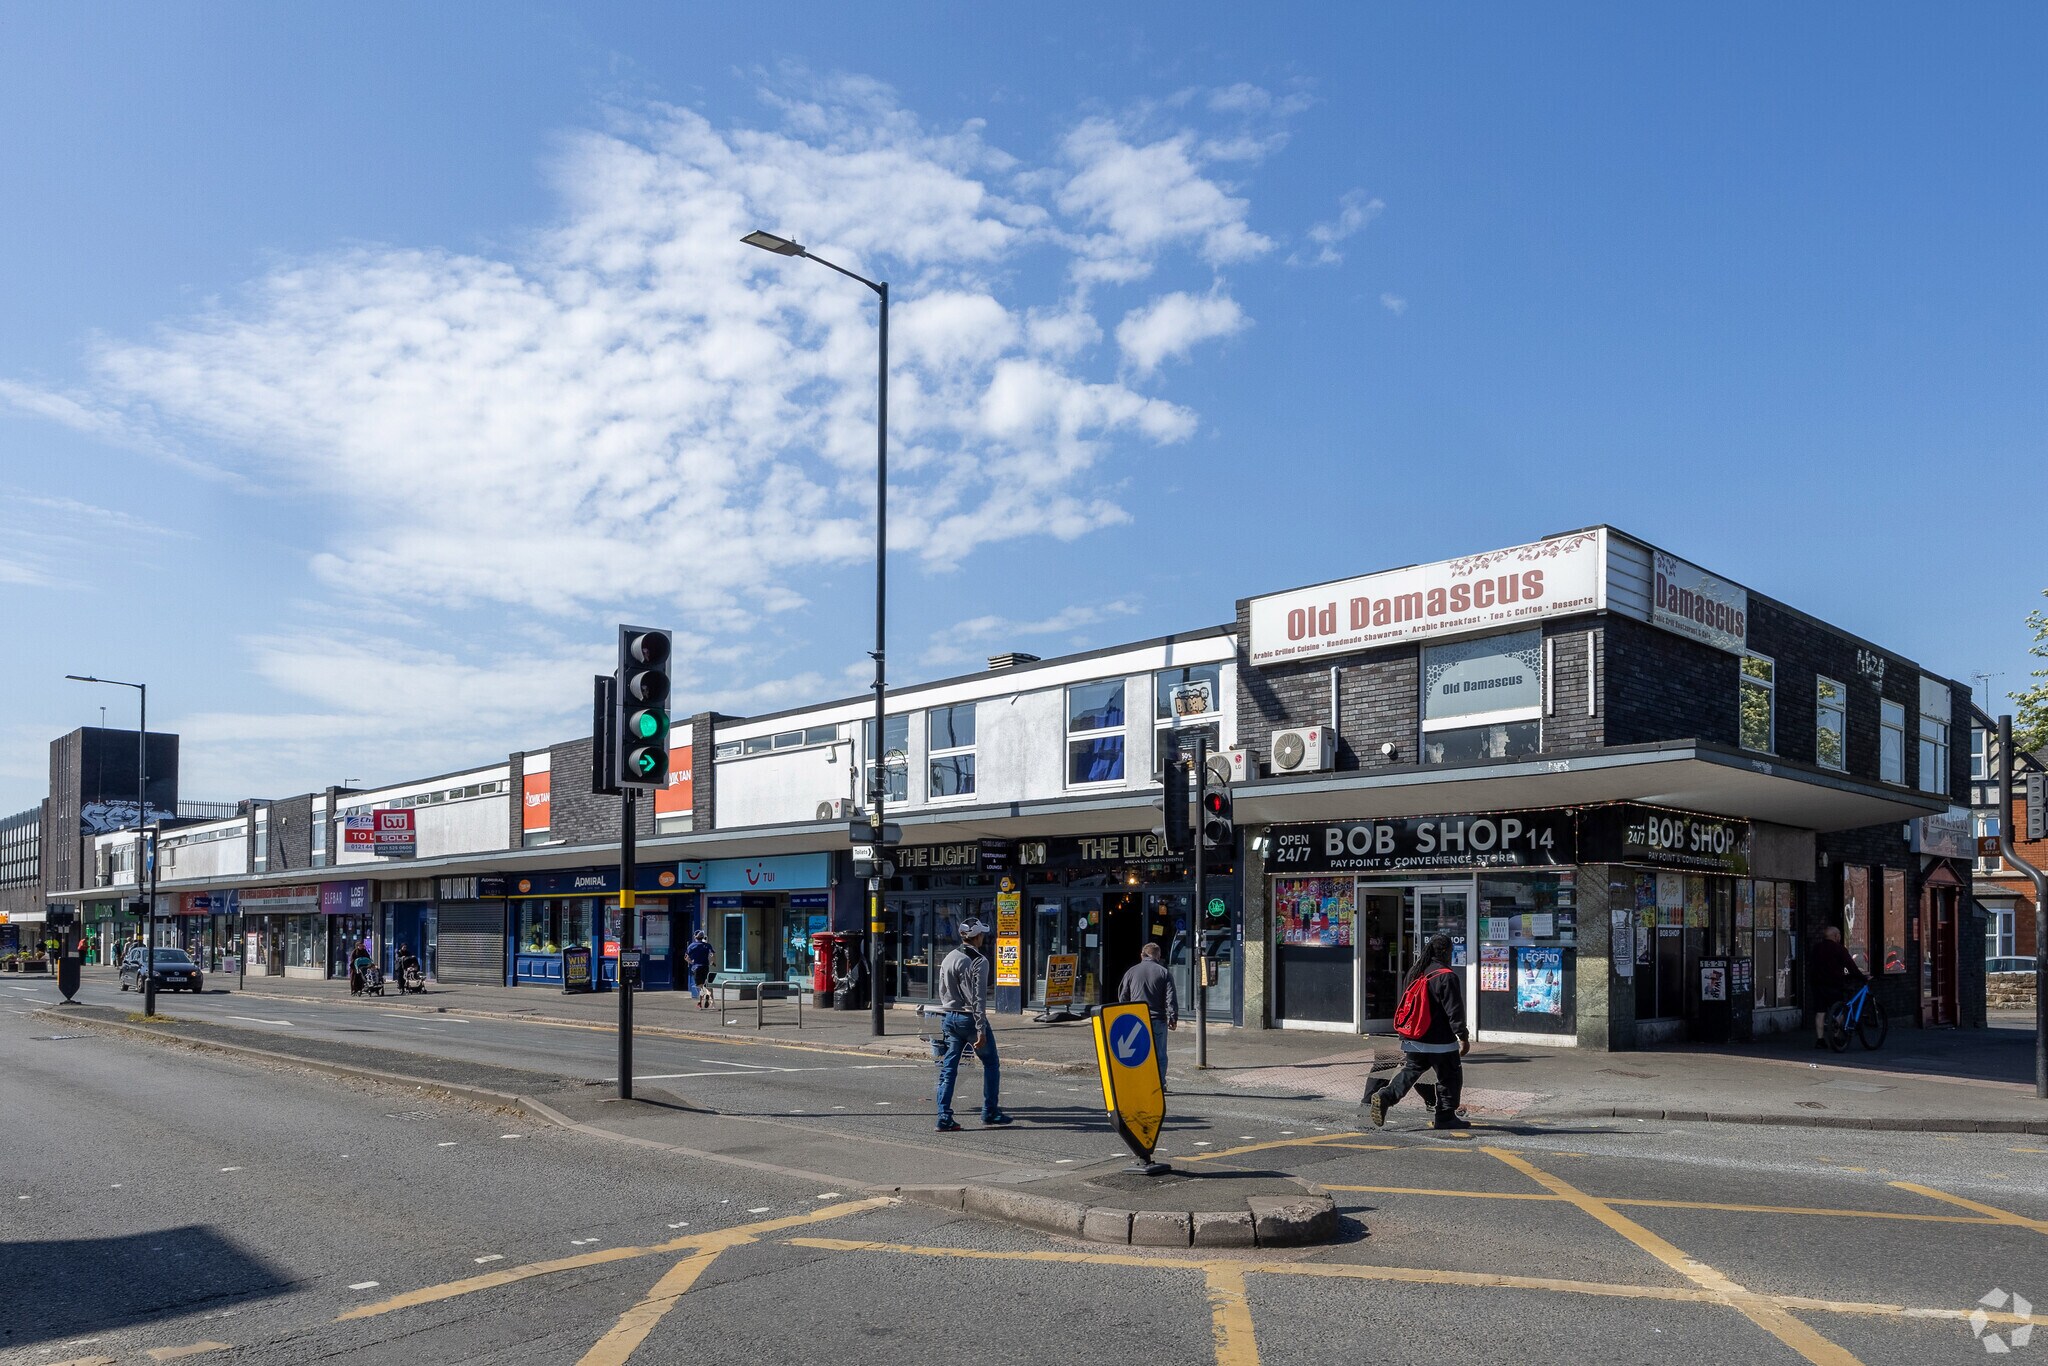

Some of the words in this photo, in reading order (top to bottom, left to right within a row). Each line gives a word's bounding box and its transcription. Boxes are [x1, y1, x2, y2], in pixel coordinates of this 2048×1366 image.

[1288, 602, 1337, 641] Old
[1350, 569, 1544, 631] Damascus
[1656, 571, 1744, 638] Damascus
[1253, 651, 1274, 660] Arabic
[1275, 646, 1296, 656] Grilled
[1297, 643, 1320, 653] Cuisine
[1326, 635, 1362, 648] Handmade
[1364, 629, 1403, 642] Shawarma
[1412, 621, 1438, 633] Arabic
[1440, 615, 1481, 629] Breakfast
[1490, 612, 1504, 621] Tea
[1514, 605, 1543, 616] Coffee
[1552, 596, 1594, 610] Desserts
[1442, 683, 1460, 695] Old
[1463, 675, 1523, 692] Damascus
[352, 832, 367, 840] TO
[1279, 834, 1310, 846] OPEN
[1325, 825, 1396, 856] BOB
[1415, 818, 1523, 853] SHOP
[1526, 828, 1555, 850] 14
[1628, 830, 1646, 845] 24/7
[1648, 816, 1685, 849] BOB
[1690, 822, 1735, 854] SHOP
[896, 848, 928, 868] THE
[930, 844, 978, 866] LIGHT
[1077, 838, 1119, 860] THE
[1277, 846, 1311, 863] 24/7
[1330, 859, 1348, 868] PAY
[1350, 858, 1381, 867] POINT
[1384, 858, 1391, 866] &
[1394, 855, 1473, 867] CONVENIENCE
[1476, 854, 1513, 863] STORE
[1648, 851, 1659, 860] PAY
[1659, 852, 1676, 862] POINT
[574, 875, 607, 888] ADMIRAL
[763, 872, 775, 882] TUI
[350, 886, 364, 897] LOST
[440, 879, 452, 900] YOU
[452, 877, 470, 899] WANT
[325, 891, 343, 905] ELFBAR
[350, 897, 364, 908] MARY
[568, 956, 587, 965] WIN
[1520, 953, 1560, 963] LEGEND
